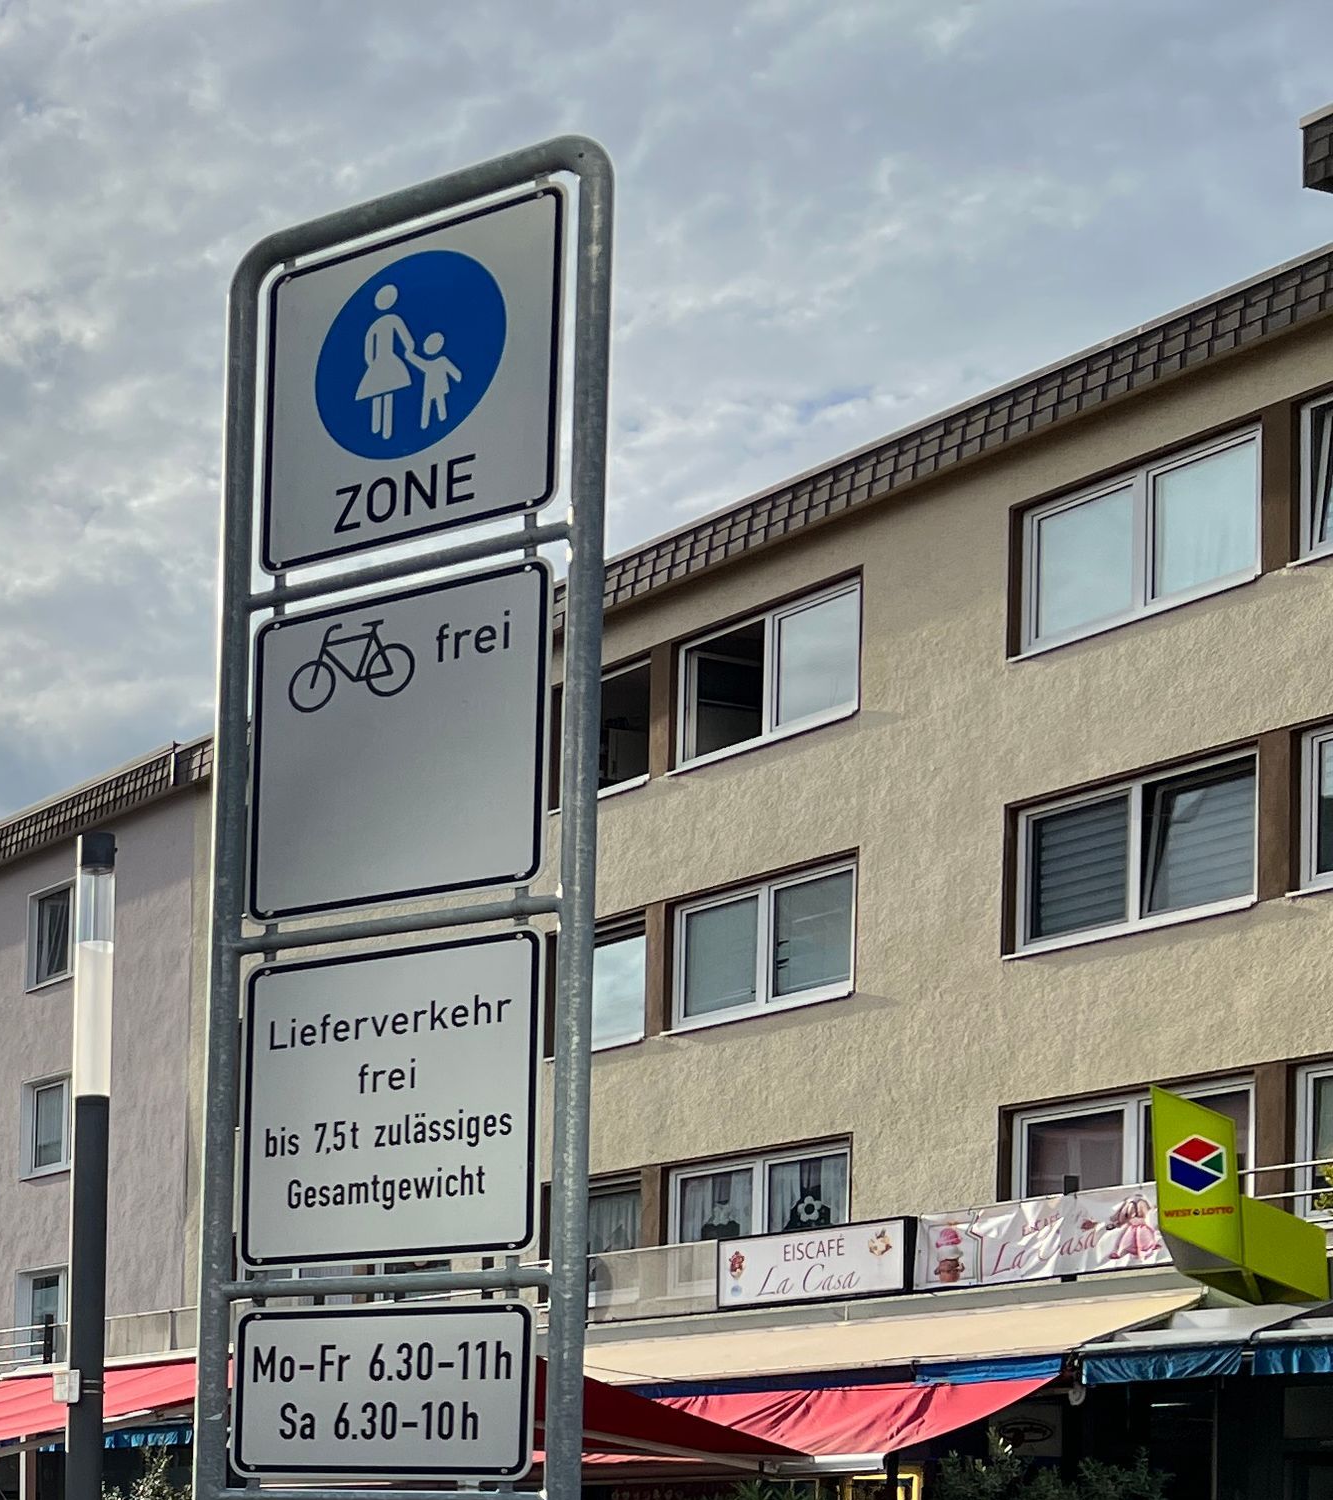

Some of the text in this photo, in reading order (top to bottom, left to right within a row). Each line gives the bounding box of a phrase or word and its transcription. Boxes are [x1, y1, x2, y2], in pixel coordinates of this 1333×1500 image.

[332, 453, 476, 534] ZONE
[435, 611, 512, 664] frei
[269, 994, 512, 1051] Lieferverkehr
[358, 1058, 416, 1094] frei
[265, 1127, 300, 1158] bis
[374, 1109, 513, 1148] zulässiges
[287, 1165, 486, 1210] Gesamtgewicht
[783, 1232, 845, 1262] EISCAFÉ
[990, 1241, 1025, 1276] La
[756, 1263, 861, 1297] La Casa
[252, 1340, 513, 1383] Mo-Fr 6.30-11h
[279, 1402, 315, 1441] Sa
